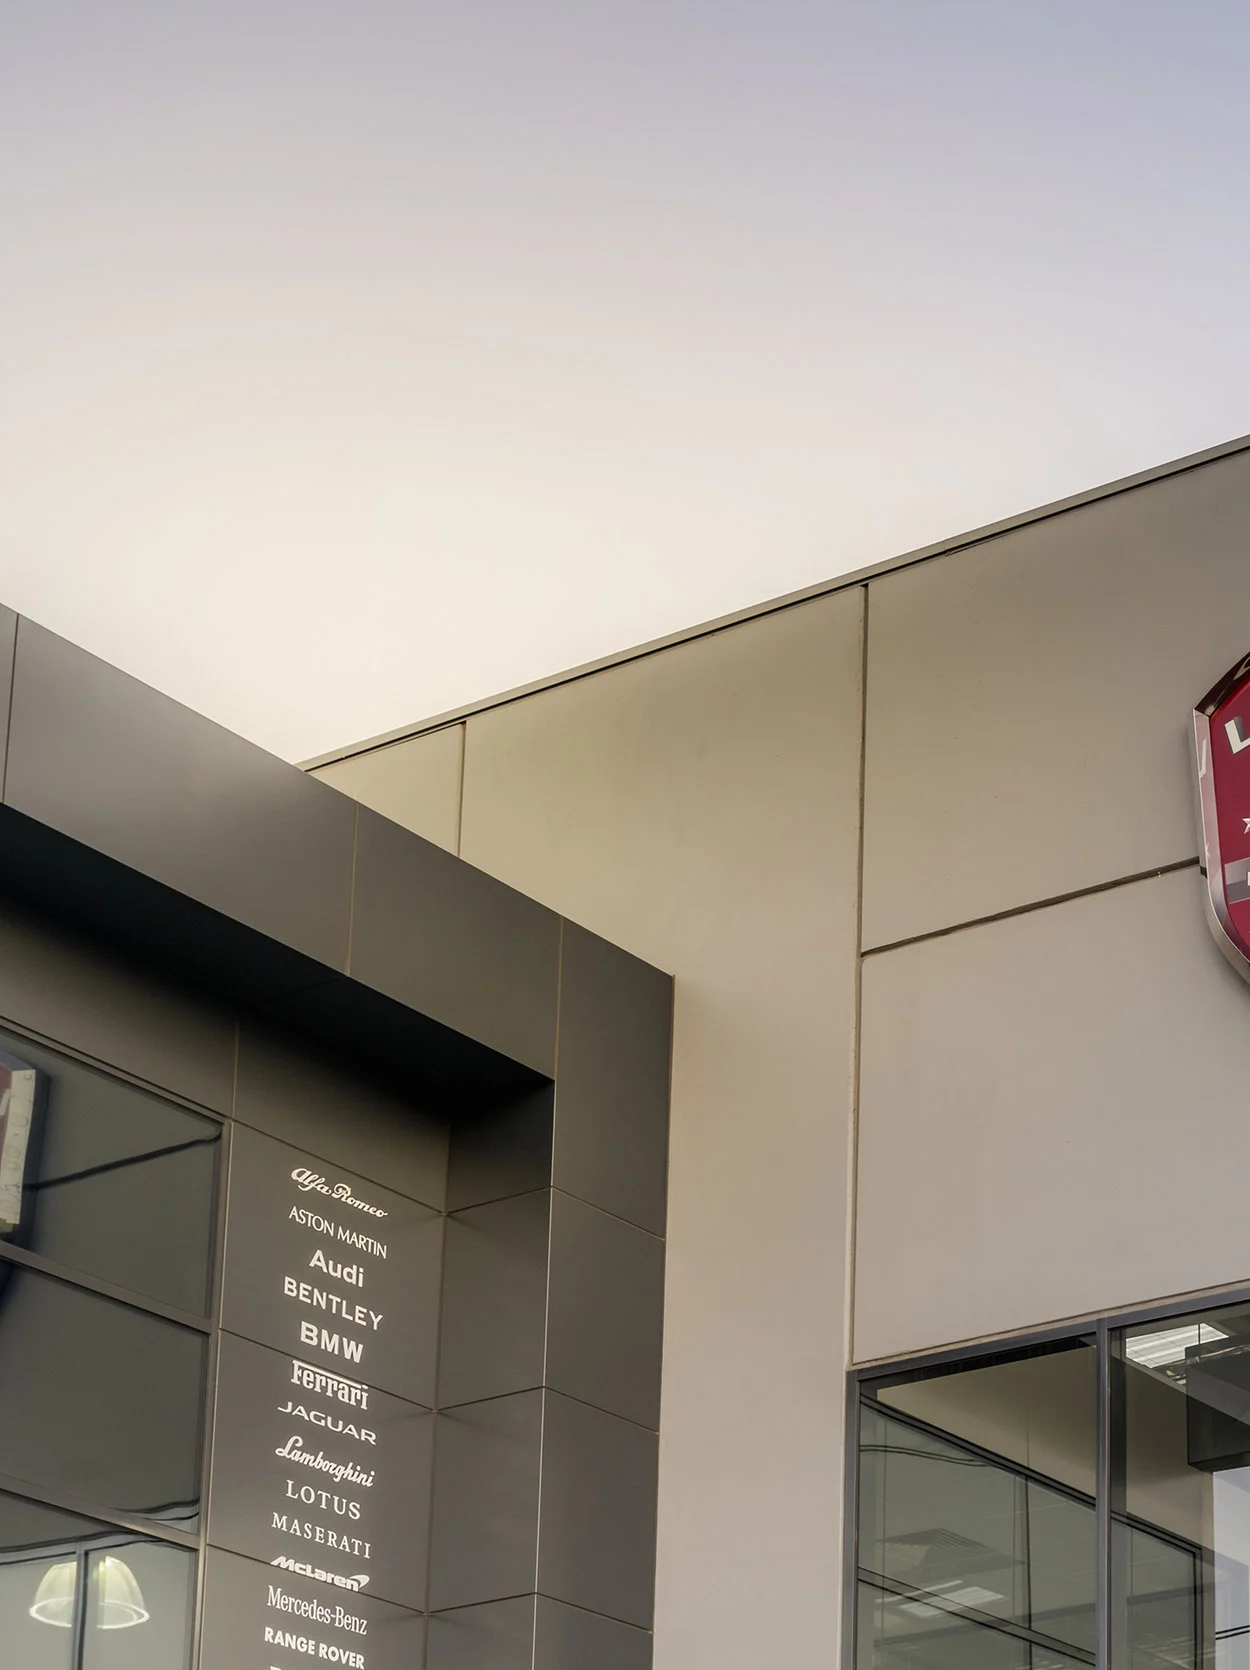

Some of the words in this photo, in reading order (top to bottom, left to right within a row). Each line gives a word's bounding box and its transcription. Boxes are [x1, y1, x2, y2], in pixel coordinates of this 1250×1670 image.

[291, 1167, 332, 1195] Alfa
[331, 1182, 388, 1218] Romeo
[289, 1206, 335, 1237] ASTON
[337, 1225, 388, 1259] MARTIN
[309, 1249, 365, 1288] Audi
[283, 1275, 383, 1331] BENTLEY
[300, 1320, 364, 1364] BMW
[290, 1359, 369, 1411] Ferrari
[277, 1401, 377, 1446] JAGUAR
[275, 1435, 376, 1488] Lamborghini
[286, 1479, 361, 1521] LOTUS
[271, 1512, 371, 1559] MASERATI
[270, 1555, 362, 1592] McLaren
[267, 1585, 368, 1636] Mercedes-Benz
[264, 1626, 315, 1656] RANGE
[318, 1643, 365, 1670] ROVER
